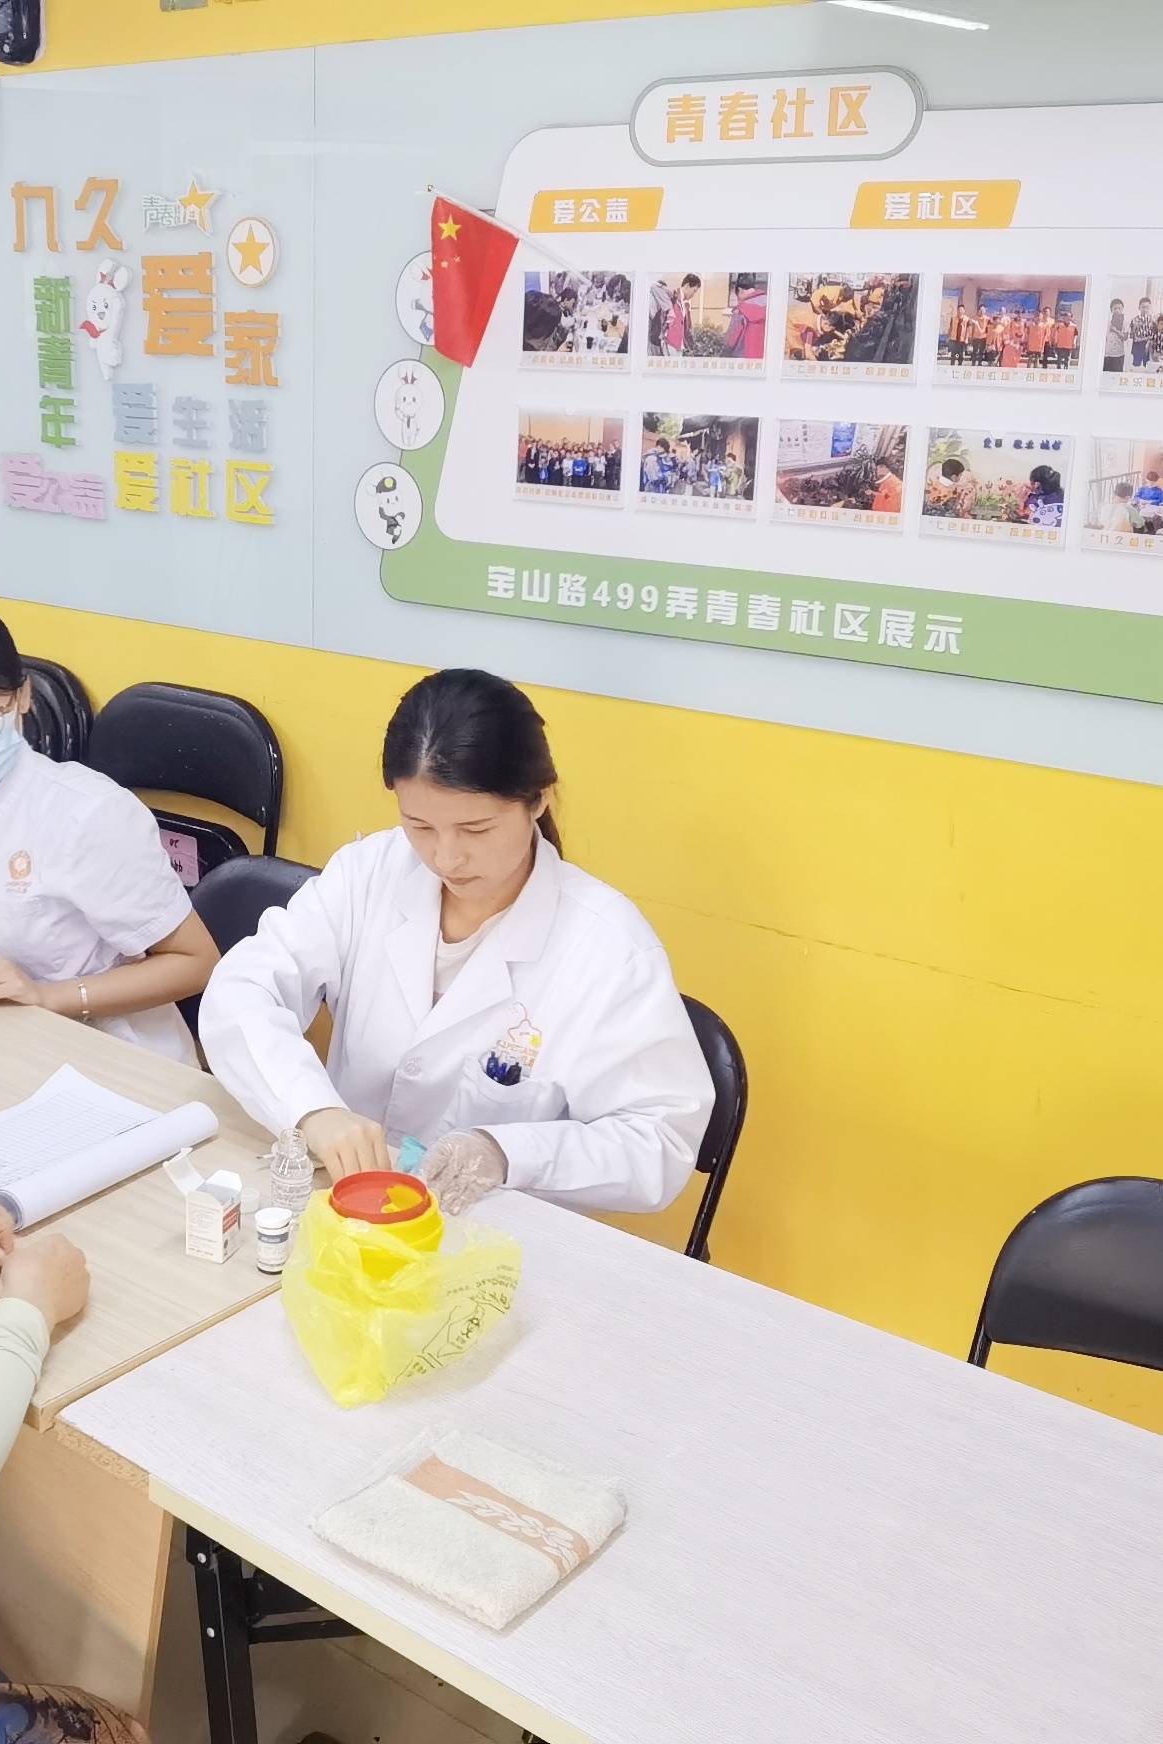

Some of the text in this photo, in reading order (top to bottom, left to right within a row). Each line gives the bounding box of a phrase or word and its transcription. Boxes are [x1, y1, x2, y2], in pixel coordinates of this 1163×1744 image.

[664, 85, 872, 144] 青春社区
[552, 196, 631, 226] 爱公益
[884, 190, 980, 222] 爱社区
[113, 450, 277, 526] 爱社区
[487, 564, 965, 656] 宝山路499弄青春社区展示
